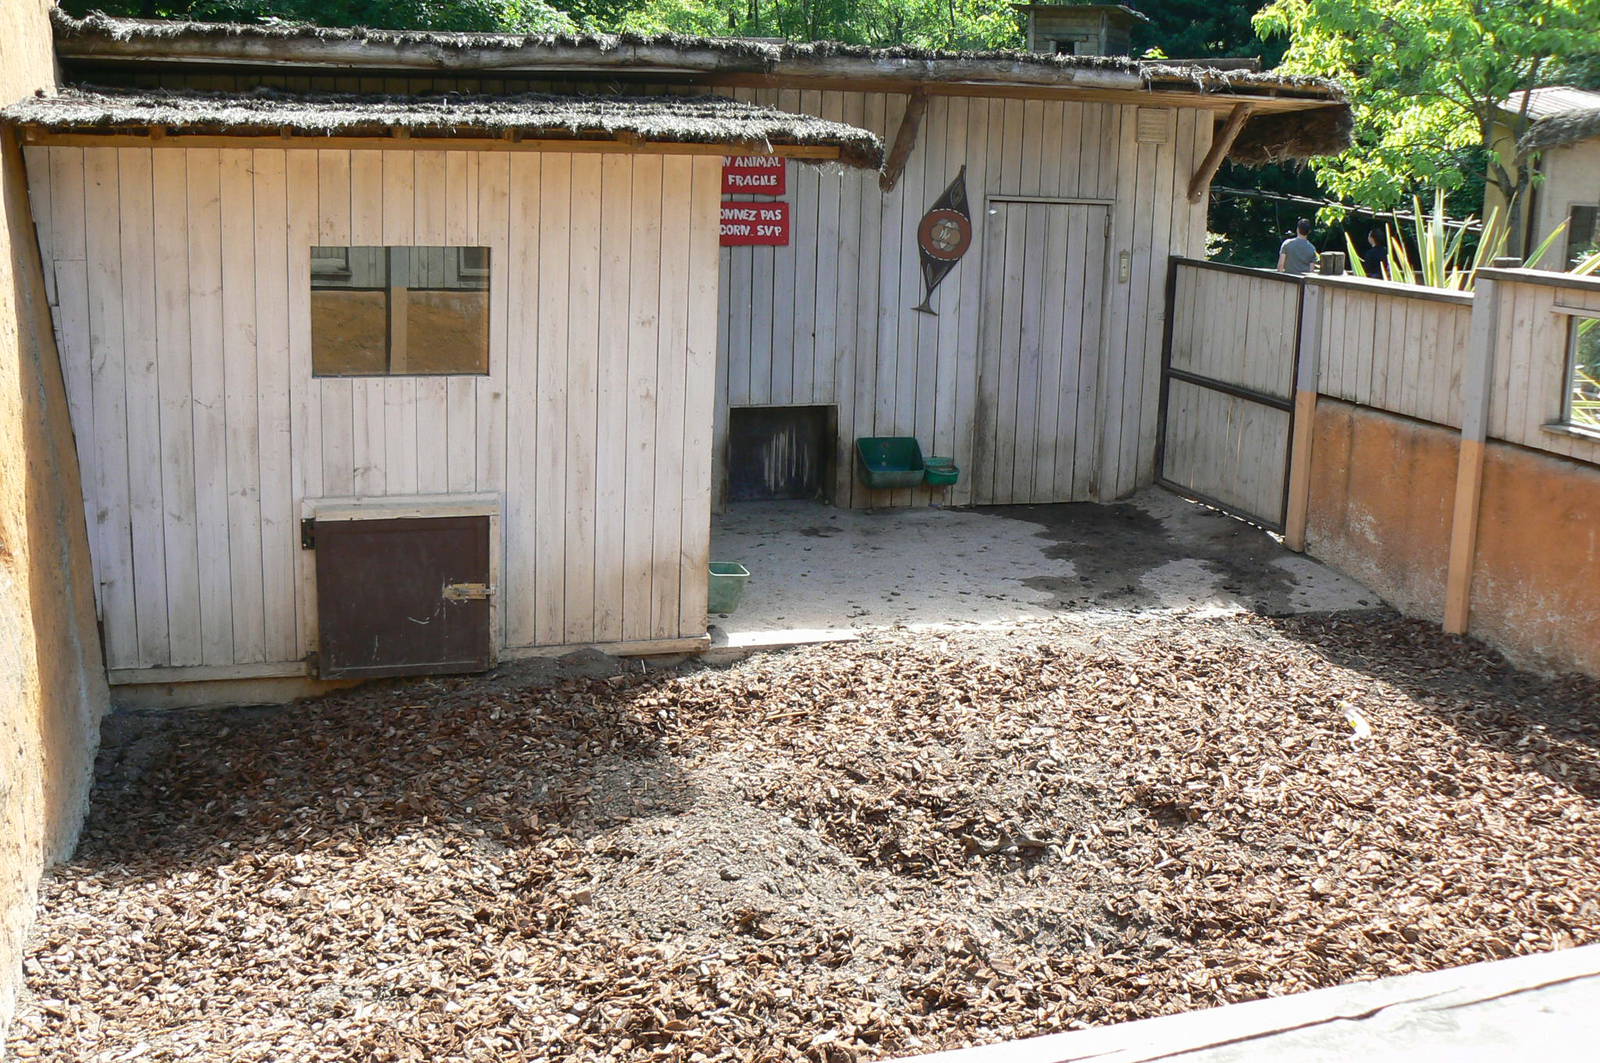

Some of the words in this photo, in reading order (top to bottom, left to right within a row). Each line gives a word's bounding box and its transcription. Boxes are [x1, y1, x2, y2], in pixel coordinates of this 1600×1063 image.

[735, 156, 781, 167] ANIMAL
[728, 174, 777, 186] FRAGILE
[760, 210, 782, 221] PAS
[757, 225, 782, 236] SVP
